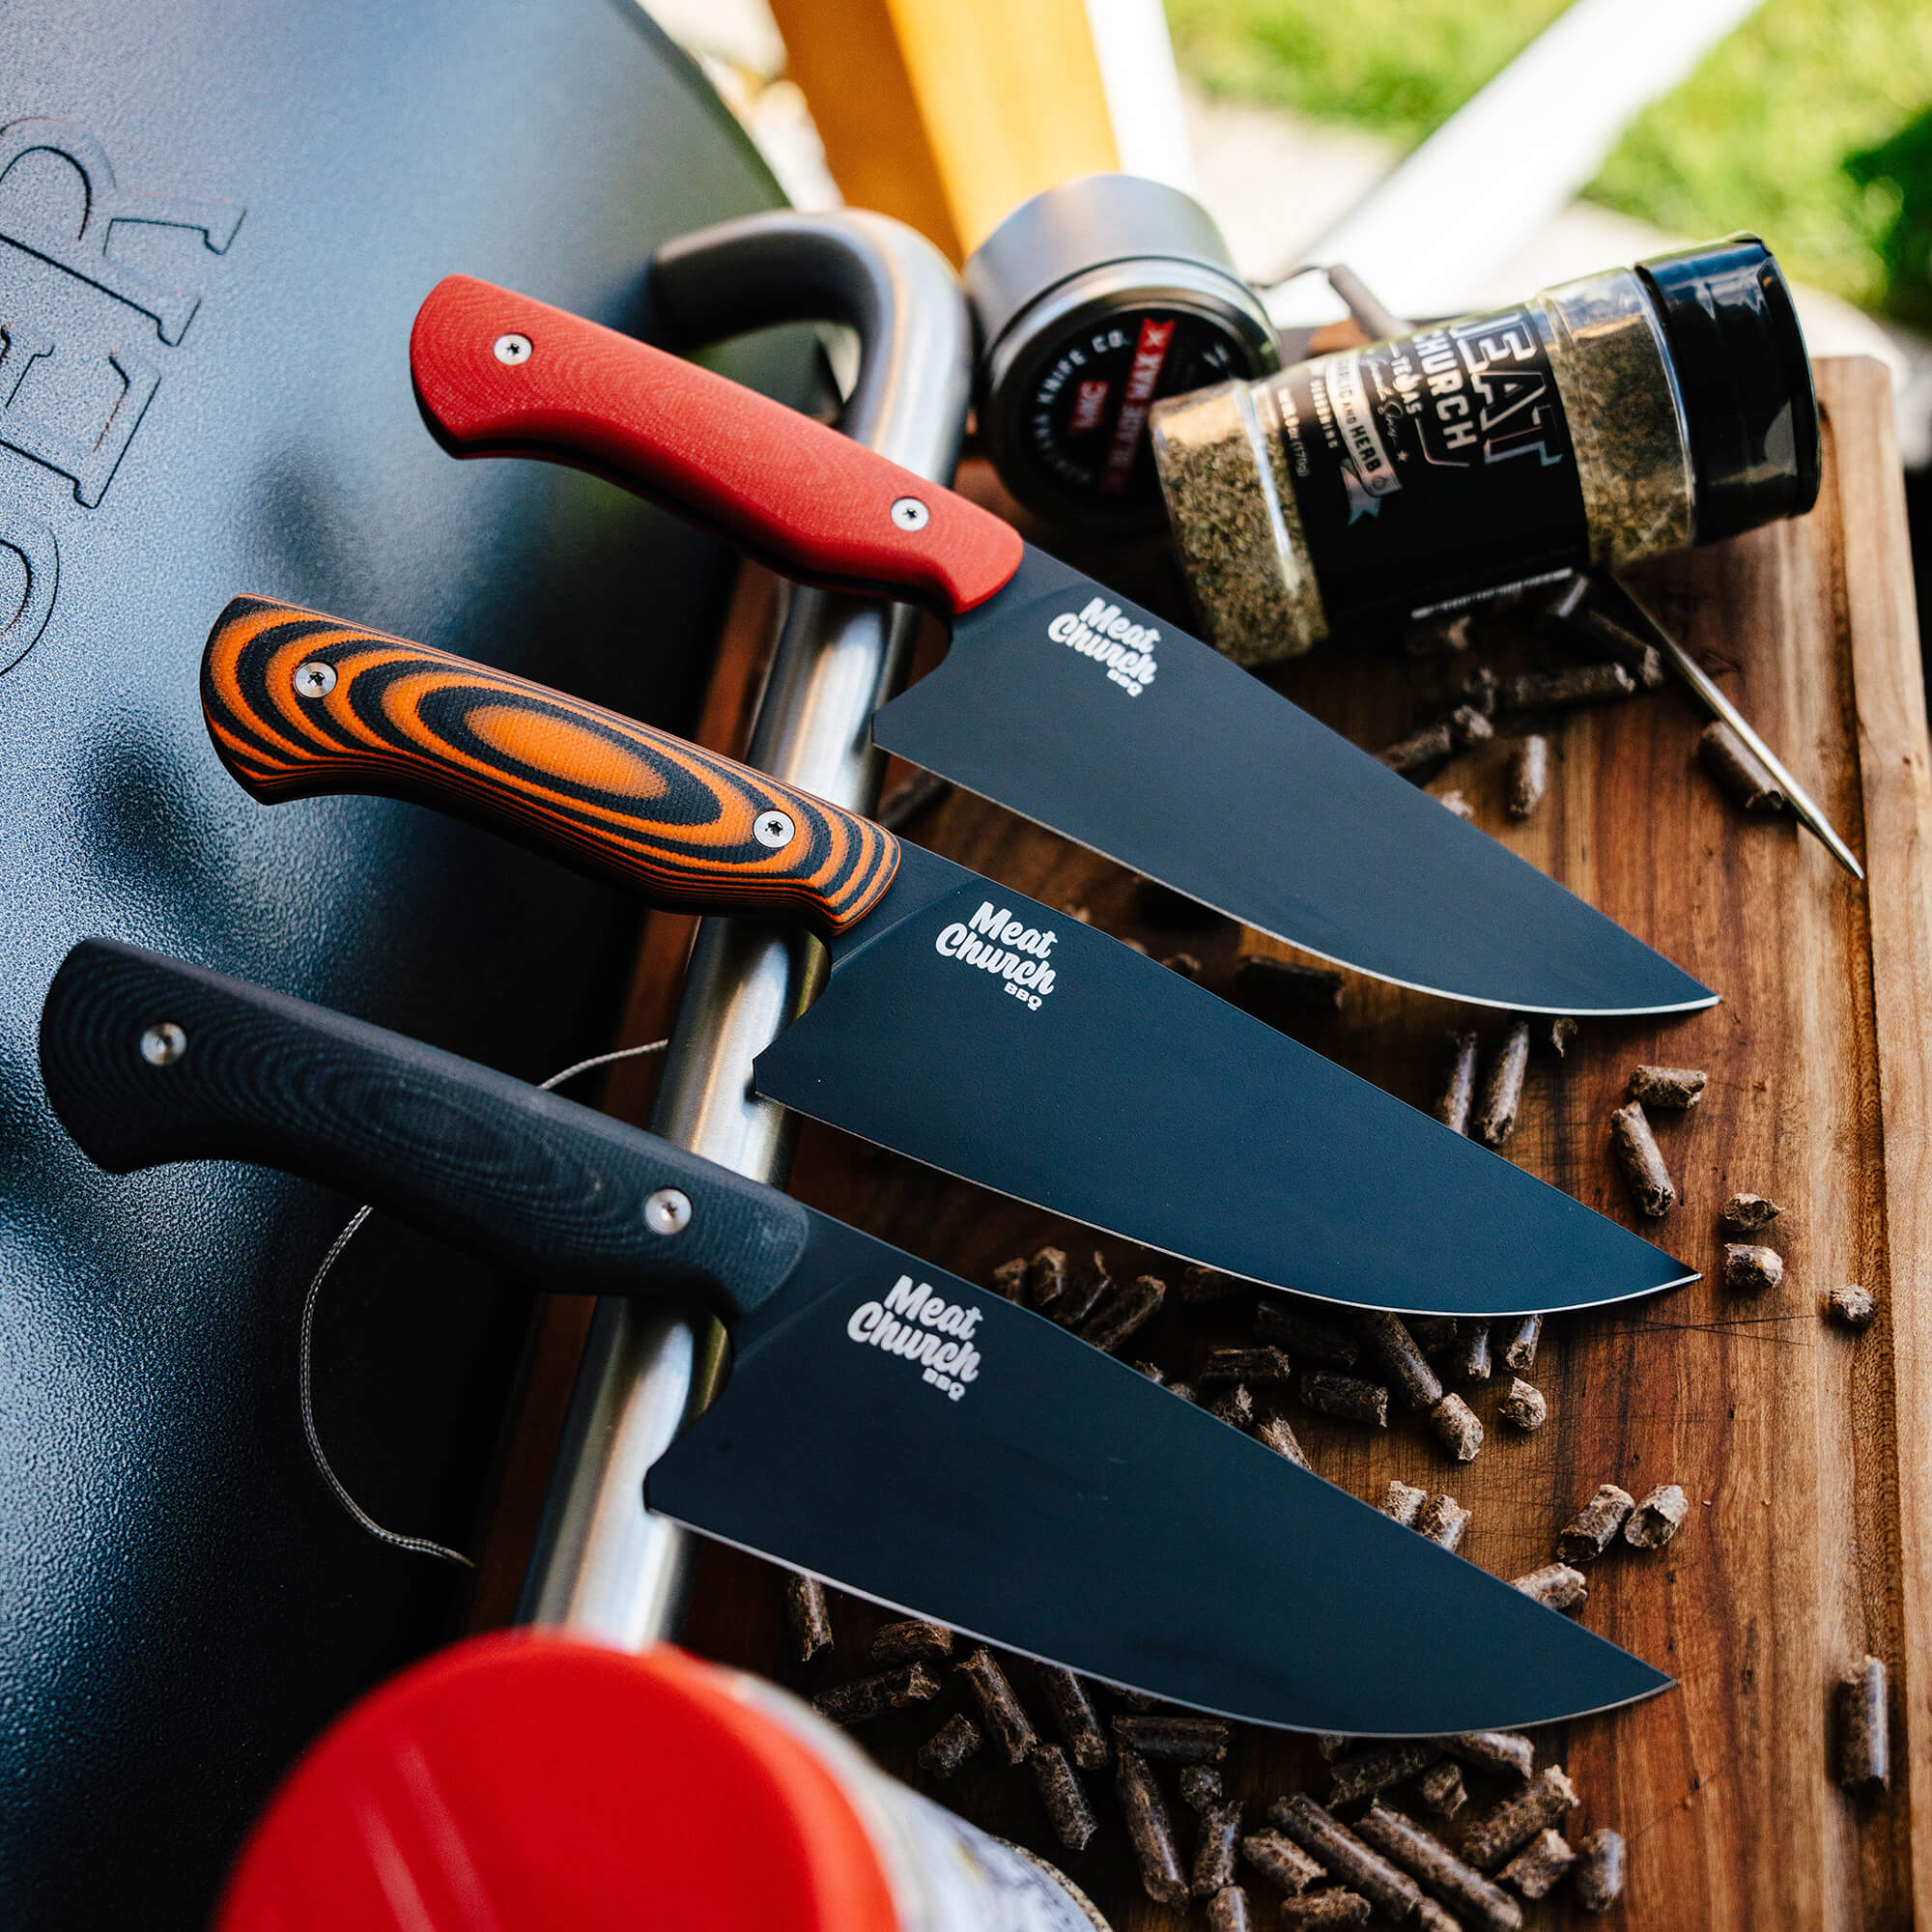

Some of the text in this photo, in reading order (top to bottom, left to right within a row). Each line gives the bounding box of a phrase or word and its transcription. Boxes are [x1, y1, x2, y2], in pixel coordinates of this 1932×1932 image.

[1037, 348, 1088, 405] KNIFE
[1128, 355, 1160, 399] WAX
[1412, 328, 1478, 450] CHURCH
[1350, 424, 1382, 471] HERB
[1048, 612, 1157, 685] Church
[1079, 597, 1161, 653] Meat
[968, 900, 1059, 959] Meat
[935, 922, 1057, 1005] Church
[1004, 981, 1043, 1011] BBQ
[884, 1274, 984, 1341] Meat
[847, 1300, 981, 1382] Church
